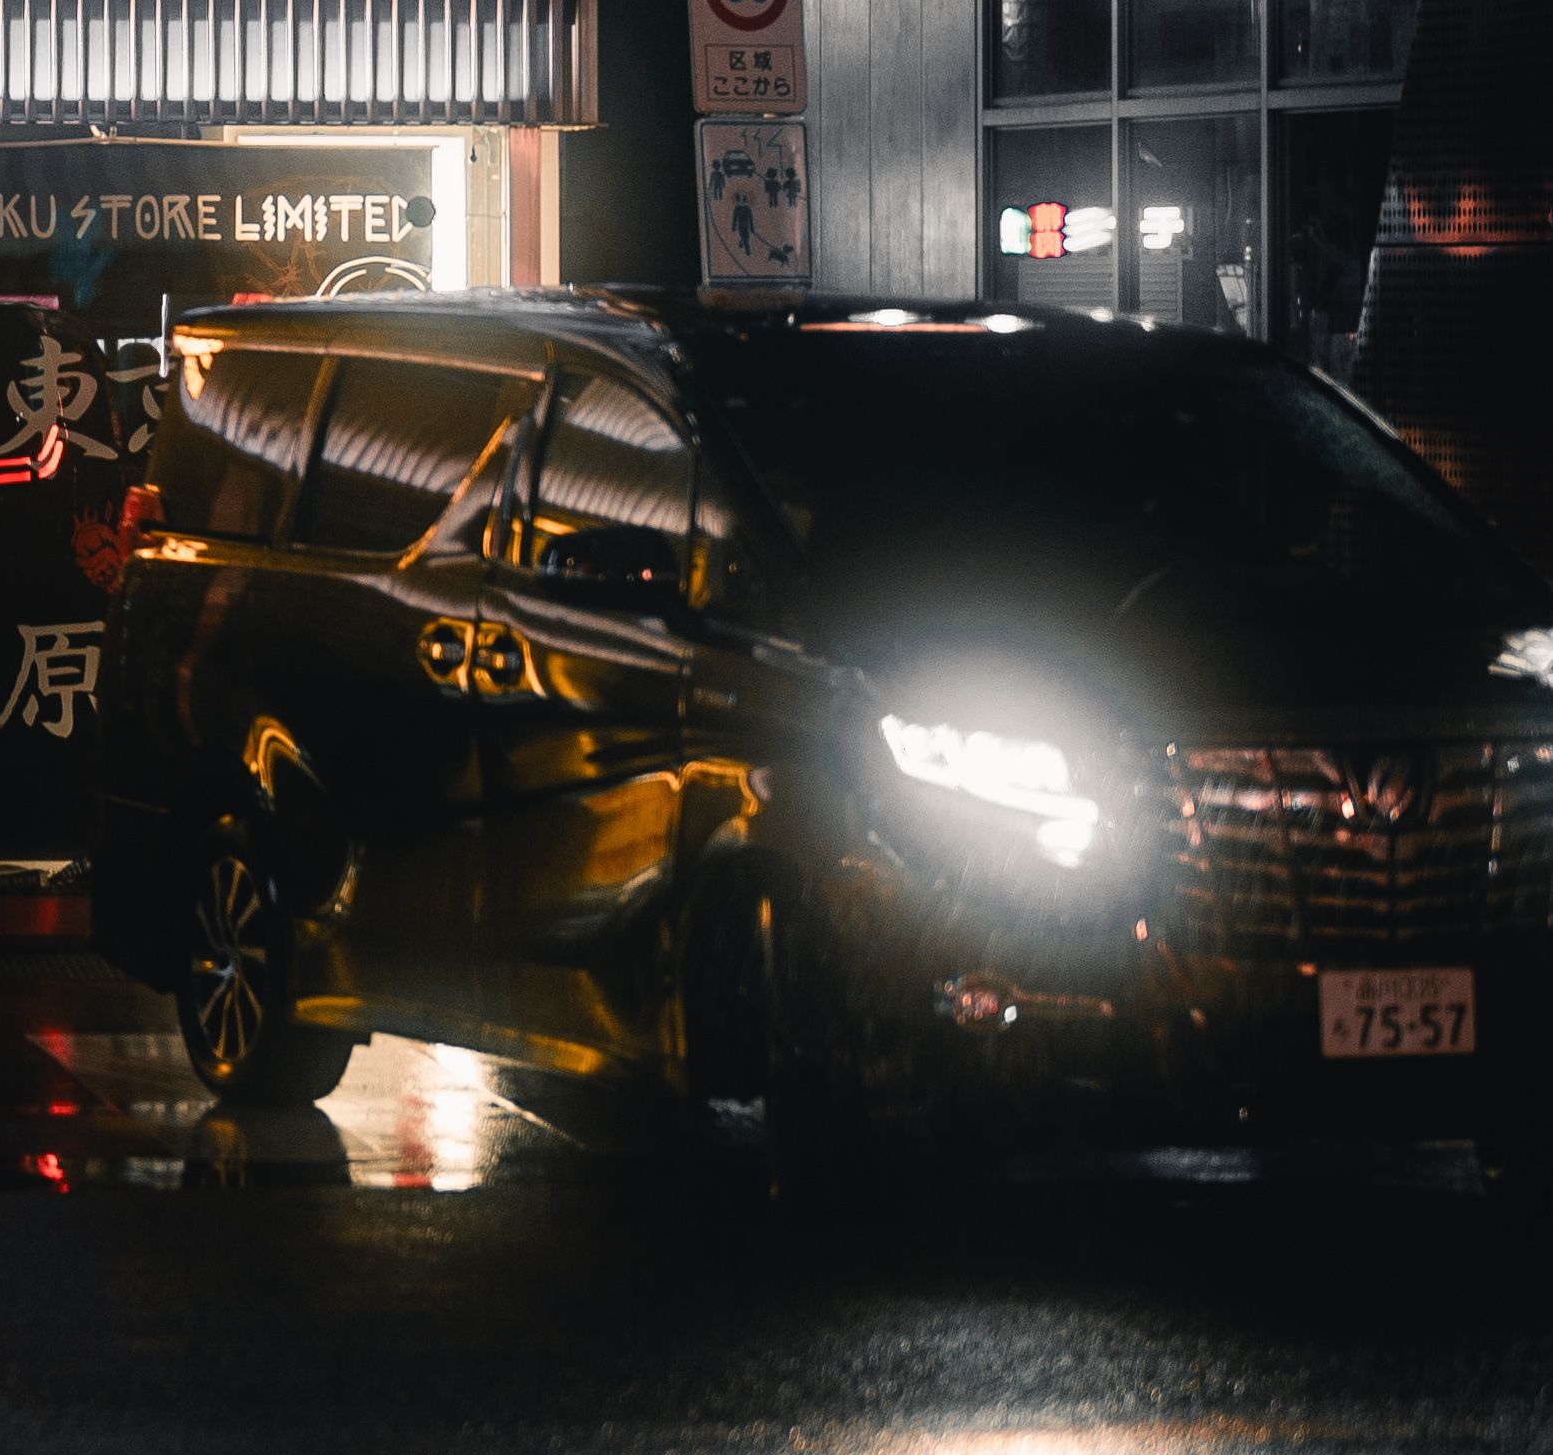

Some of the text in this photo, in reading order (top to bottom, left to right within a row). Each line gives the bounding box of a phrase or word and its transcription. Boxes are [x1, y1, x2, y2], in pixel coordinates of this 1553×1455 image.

[728, 49, 774, 74] 区域
[711, 75, 791, 98] ここから
[71, 194, 222, 241] STORE
[235, 194, 414, 243] LIMITED
